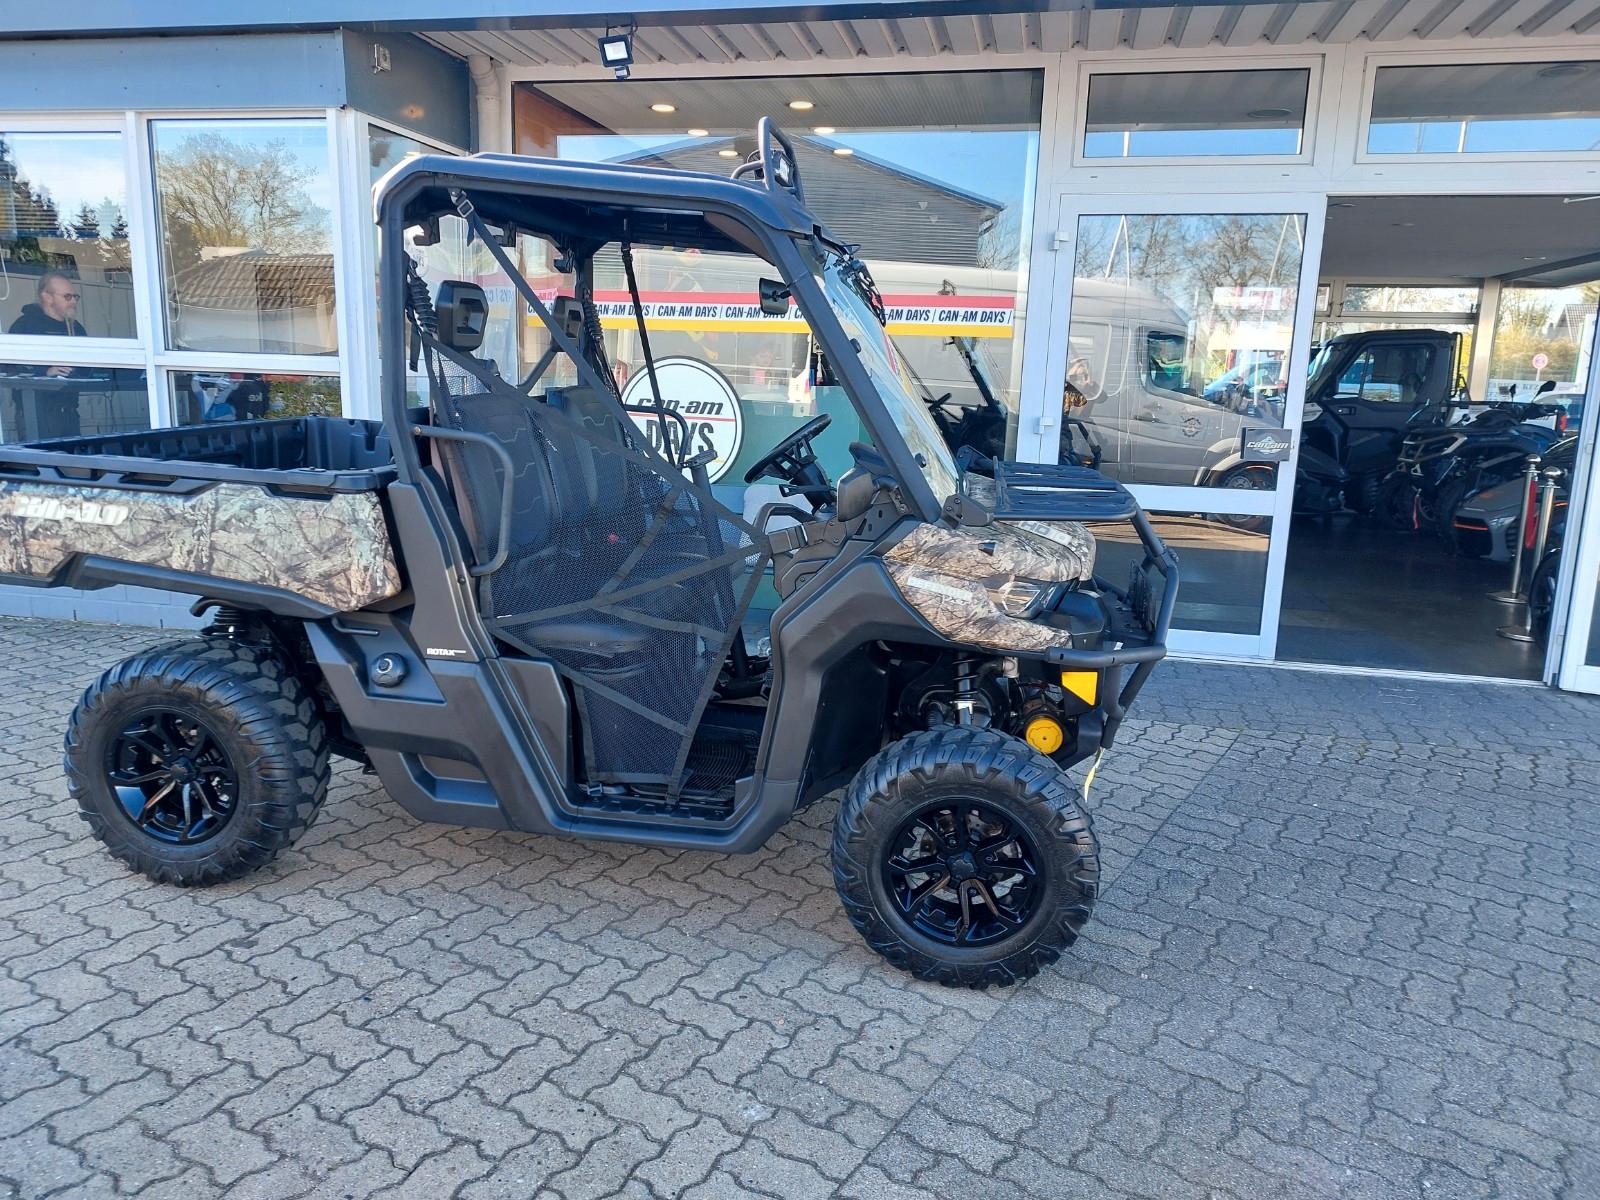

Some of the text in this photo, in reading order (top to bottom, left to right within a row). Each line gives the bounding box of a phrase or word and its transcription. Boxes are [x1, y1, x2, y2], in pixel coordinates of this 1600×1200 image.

[657, 305, 693, 317] CAN-AM
[694, 306, 717, 318] DAYS
[725, 307, 762, 319] CAN-AM
[905, 309, 930, 321] DAYS
[939, 310, 979, 322] CAN-AM
[980, 311, 1006, 323] DAYS
